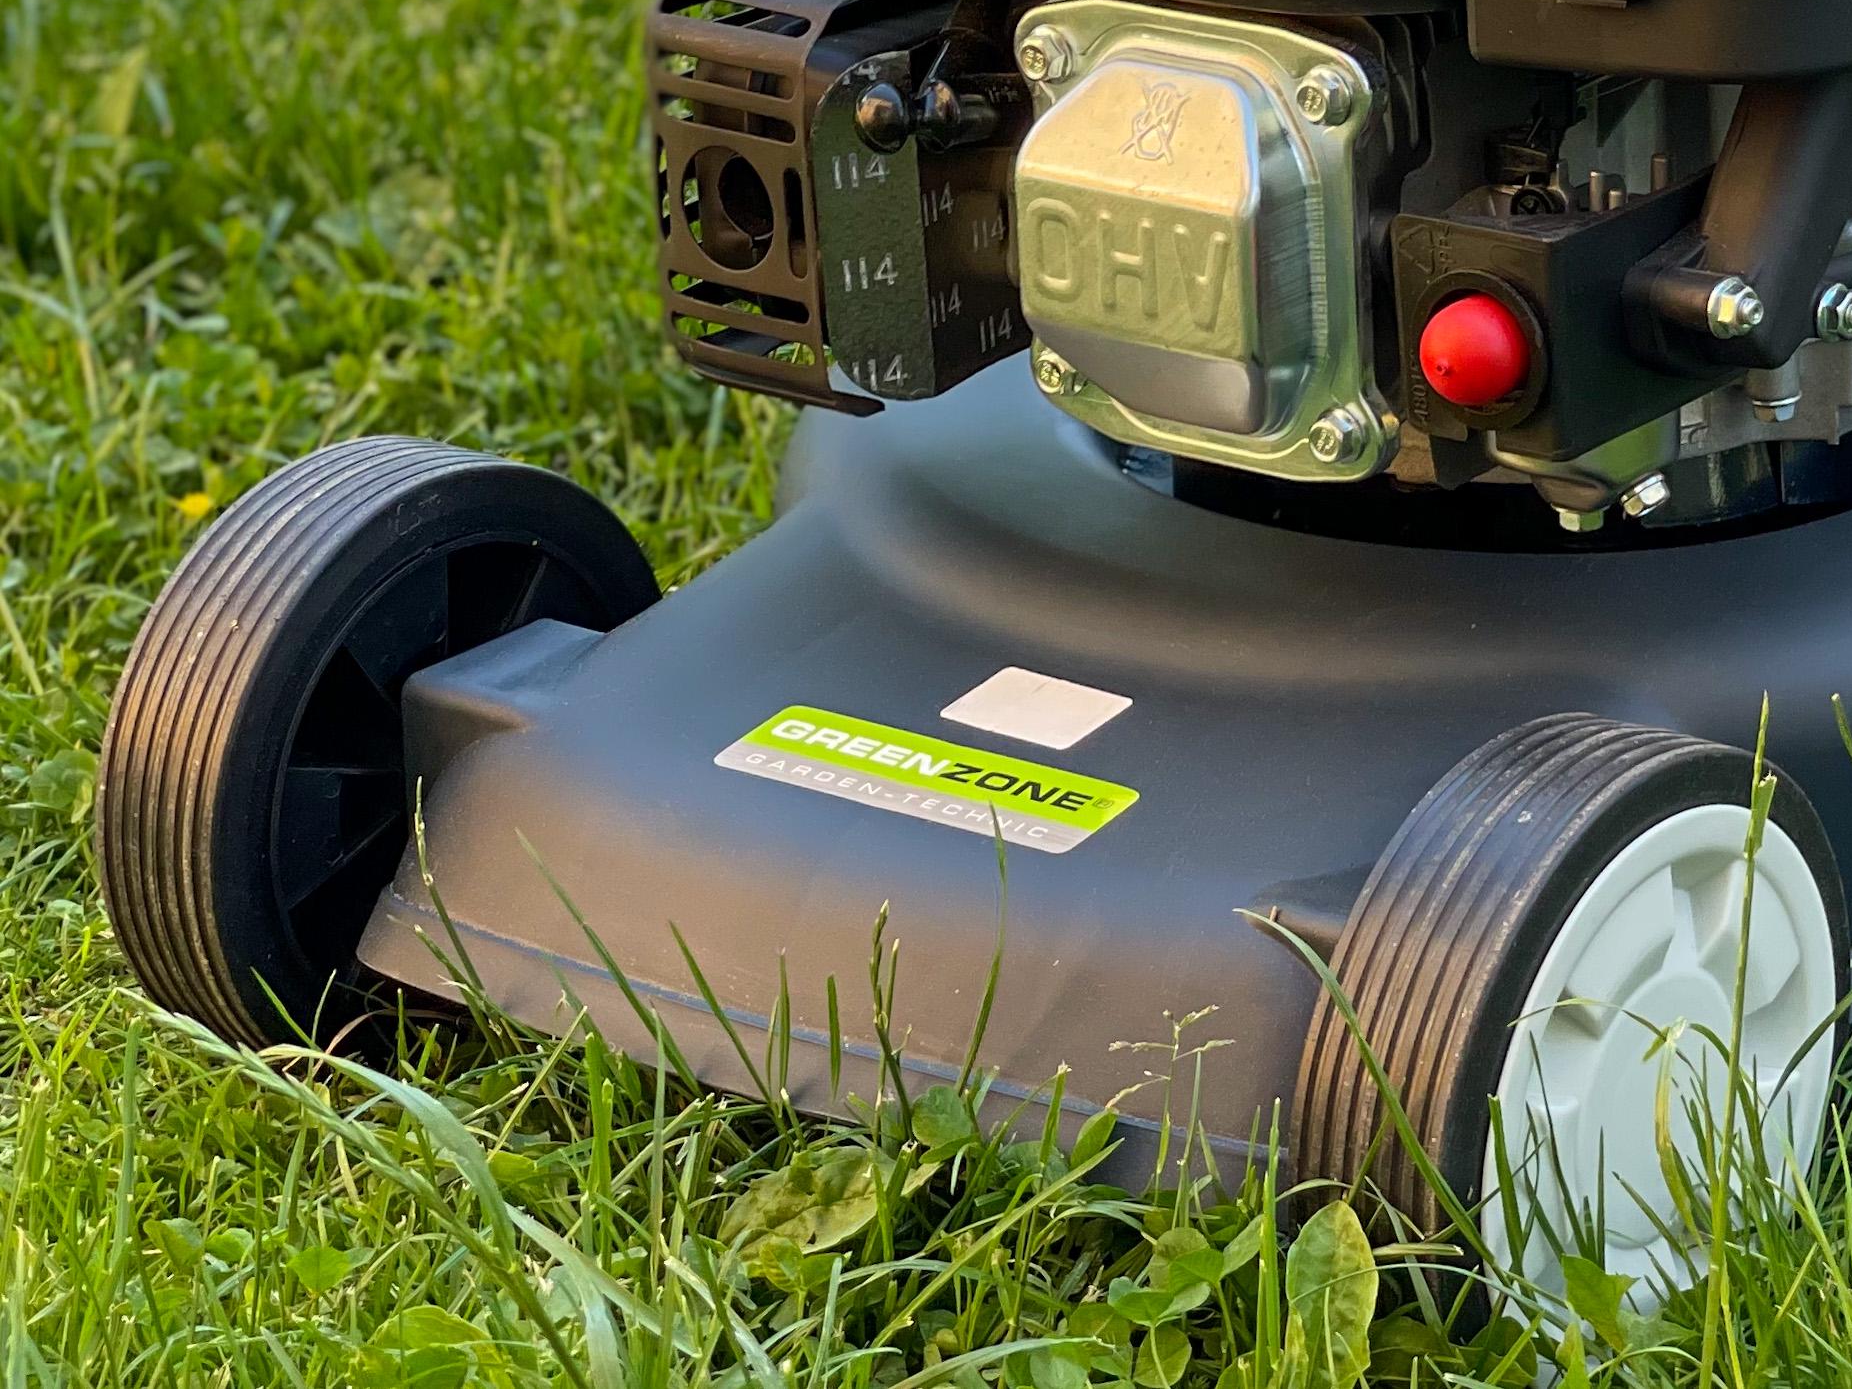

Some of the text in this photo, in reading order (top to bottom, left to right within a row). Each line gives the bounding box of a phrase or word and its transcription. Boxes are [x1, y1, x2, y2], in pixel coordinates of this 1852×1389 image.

[830, 152, 890, 191] 114
[921, 181, 955, 228] 114
[971, 208, 1007, 253] 114
[841, 251, 900, 293] 114
[1025, 196, 1231, 334] OHV
[930, 282, 962, 329] 114
[978, 307, 1014, 354] 114
[770, 718, 1094, 812] GREENZONE
[744, 752, 1050, 840] GARDEN-TECHNIC
